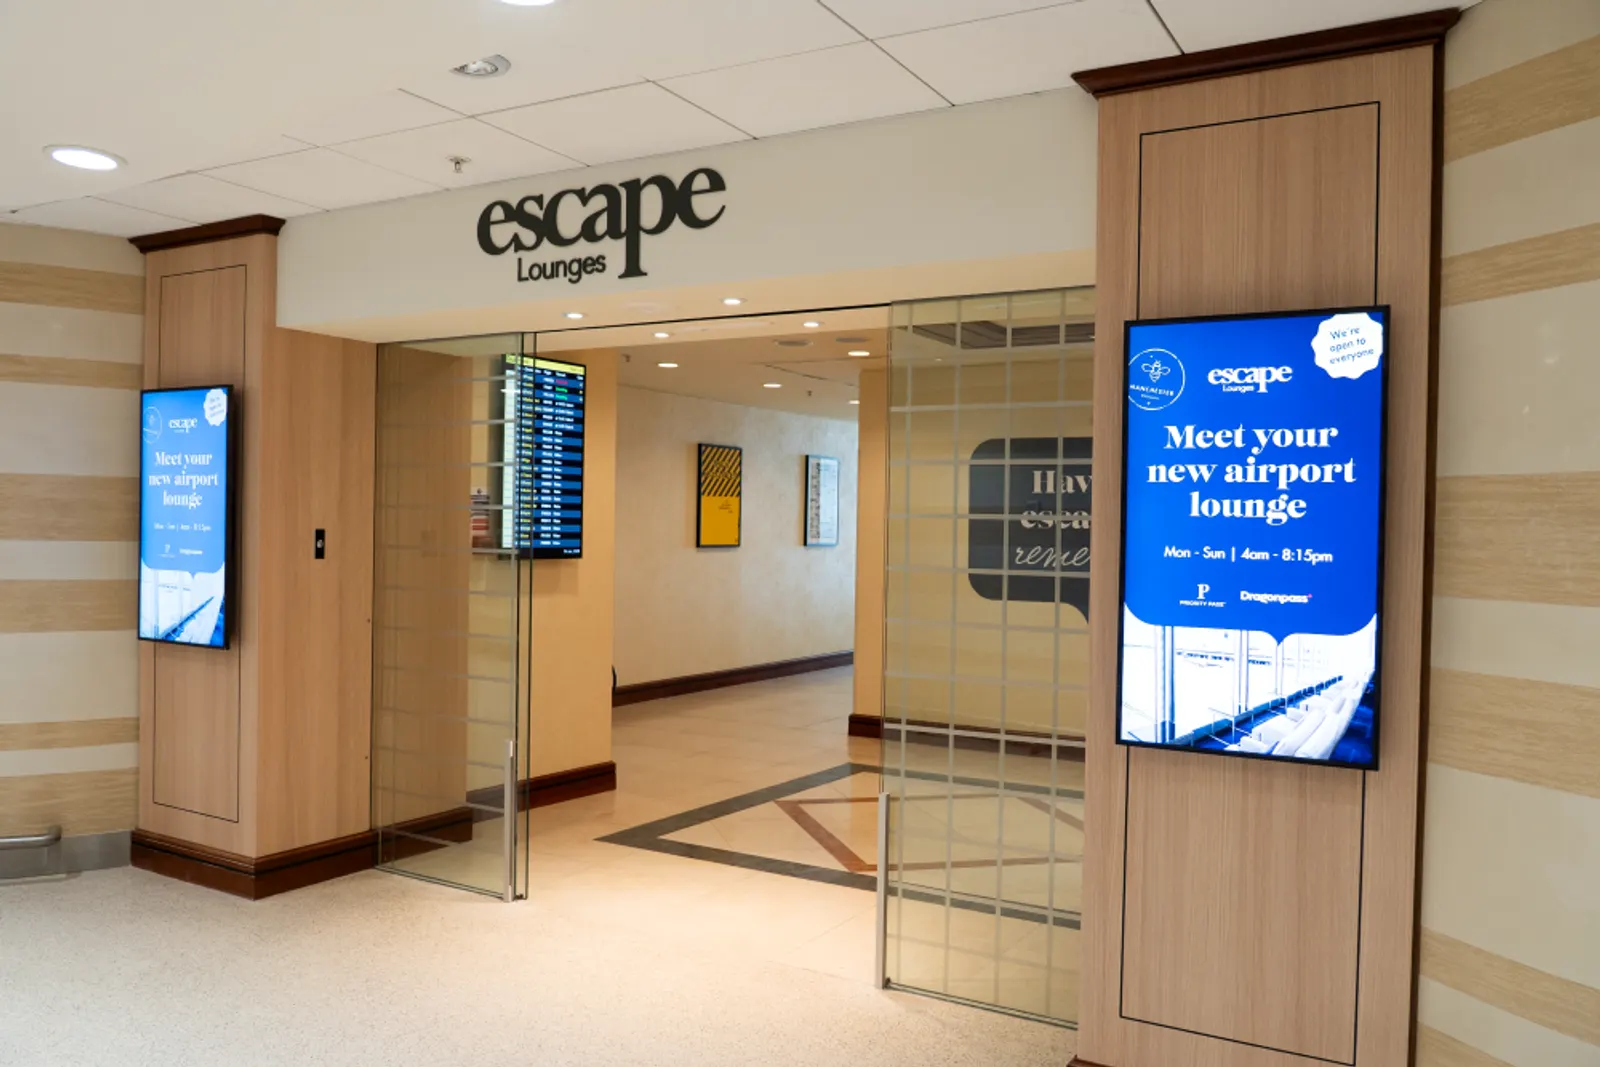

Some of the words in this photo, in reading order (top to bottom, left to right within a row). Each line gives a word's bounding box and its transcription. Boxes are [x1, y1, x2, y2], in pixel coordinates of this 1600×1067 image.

[477, 167, 726, 279] escape
[517, 254, 606, 284] Lounges
[1329, 327, 1360, 340] We're
[1329, 340, 1354, 352] open
[1356, 337, 1367, 346] to
[1329, 348, 1374, 365] everyone
[1207, 365, 1293, 393] escape
[1222, 384, 1255, 394] Lounges
[1163, 424, 1246, 449] Meet
[1251, 427, 1339, 455] your
[155, 451, 182, 466] Meet
[184, 453, 213, 470] your
[148, 475, 171, 486] new
[174, 470, 219, 490] airport
[1146, 463, 1218, 483] new
[1224, 456, 1357, 490] airport
[163, 489, 203, 510] lounge
[1189, 491, 1307, 526] lounge
[1163, 545, 1191, 558] Mon
[1203, 546, 1226, 560] Sun
[1240, 547, 1270, 561] 4am
[1281, 549, 1333, 565] 8:15pm
[1197, 583, 1210, 600] P
[1240, 590, 1308, 605] Dragonpass
